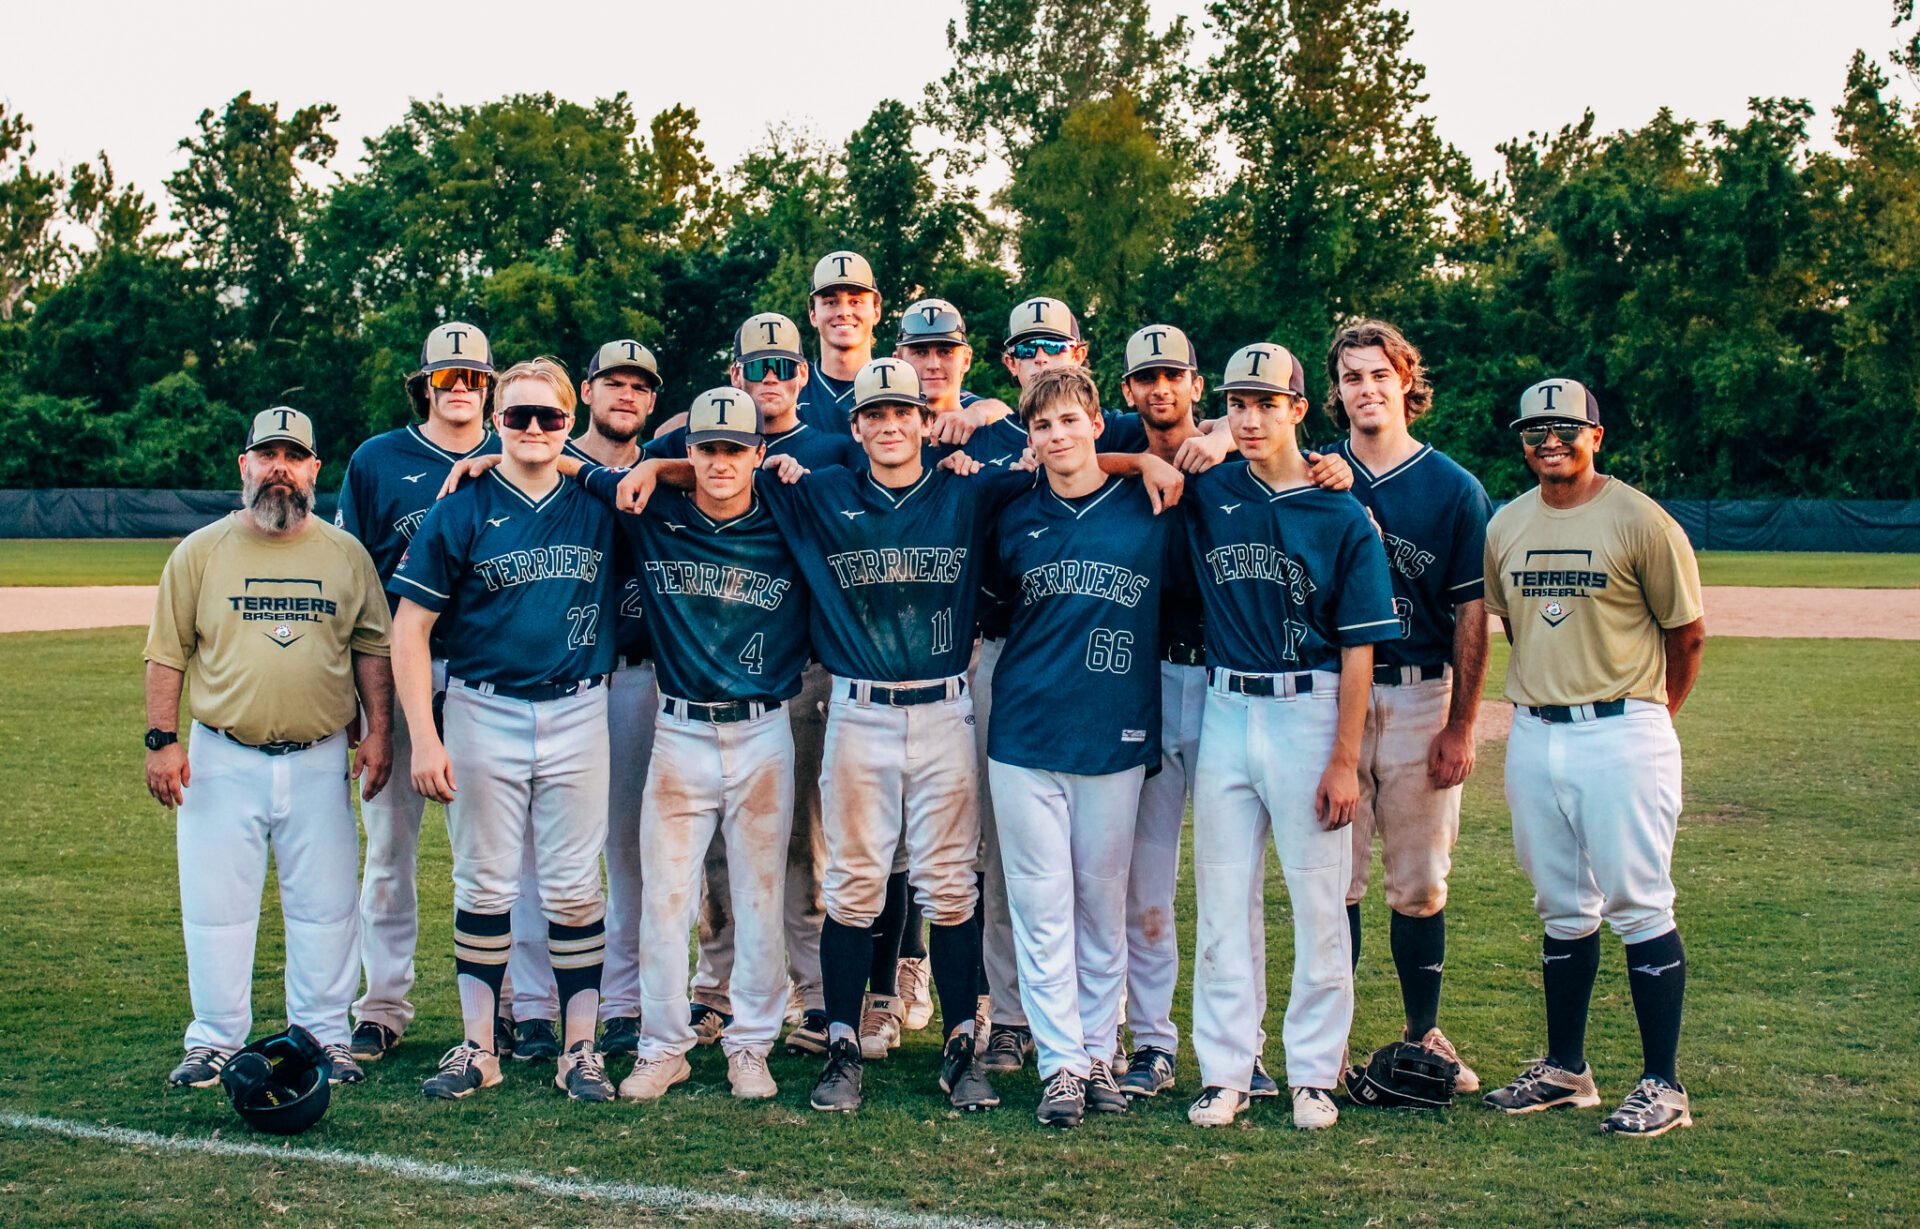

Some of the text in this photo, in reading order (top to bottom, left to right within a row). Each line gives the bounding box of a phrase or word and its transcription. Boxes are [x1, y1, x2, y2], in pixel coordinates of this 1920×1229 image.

[832, 256, 853, 278] T
[1027, 301, 1050, 324] T
[446, 331, 468, 355] T
[759, 321, 782, 345] T
[1143, 331, 1167, 356] T
[621, 342, 642, 362] T
[1246, 350, 1270, 377] T
[872, 364, 896, 389] T
[1538, 384, 1563, 410] T
[273, 409, 296, 431] T
[711, 398, 735, 425] T
[474, 544, 602, 592] TERRIERS
[827, 547, 967, 588] TERRIERS
[1206, 543, 1317, 605] TERRIERS
[1510, 570, 1608, 589] TERRIERS
[645, 561, 791, 611] TERRIERS
[1522, 588, 1590, 598] BASEBALL
[226, 596, 337, 616] TERRIERS
[242, 612, 323, 623] BASEBALL
[567, 603, 600, 650] 22
[931, 607, 953, 655] 11
[738, 632, 764, 675] 4
[1086, 628, 1134, 674] 66
[872, 1000, 890, 1010] NIKE
